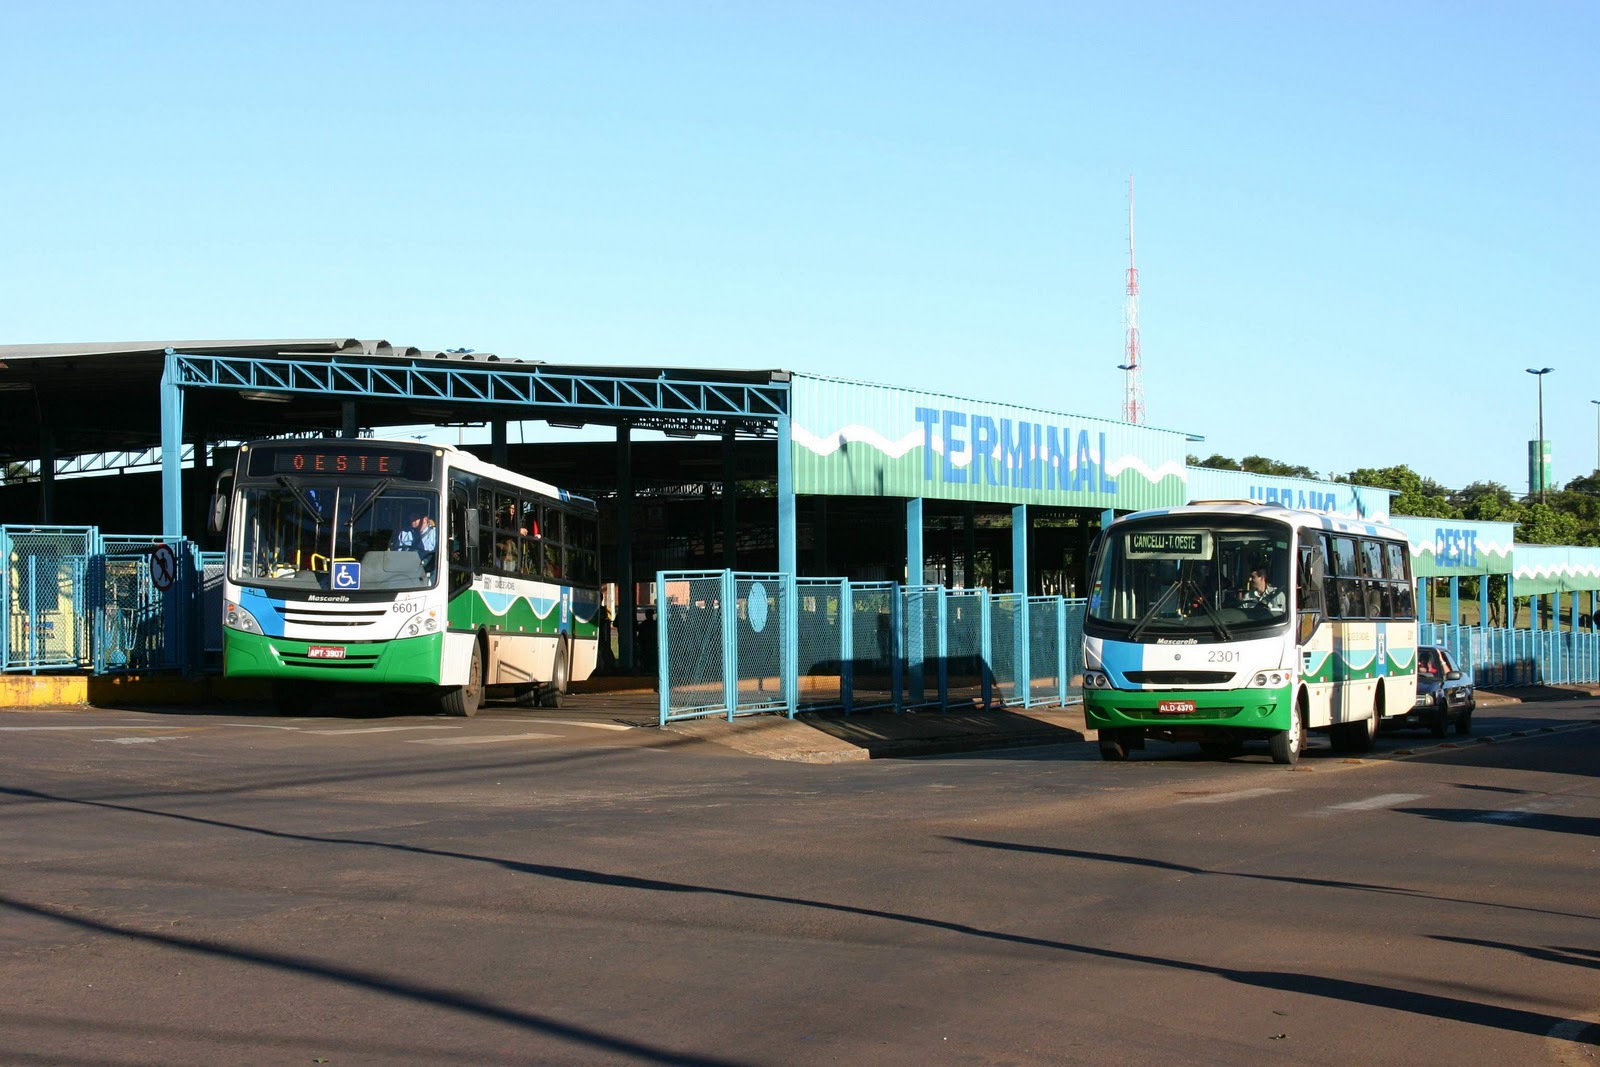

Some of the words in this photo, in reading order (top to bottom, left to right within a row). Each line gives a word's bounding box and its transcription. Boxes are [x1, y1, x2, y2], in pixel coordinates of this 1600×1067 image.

[915, 406, 1117, 495] TERMINAL
[293, 454, 389, 472] OESTE
[1133, 535, 1165, 548] CANCELLI
[1175, 536, 1196, 549] OESTE
[1435, 528, 1477, 568] OESTE
[308, 594, 350, 603] Mascarello
[392, 602, 418, 613] 6601
[1156, 638, 1199, 646] Mascarello
[1207, 650, 1241, 663] 2301
